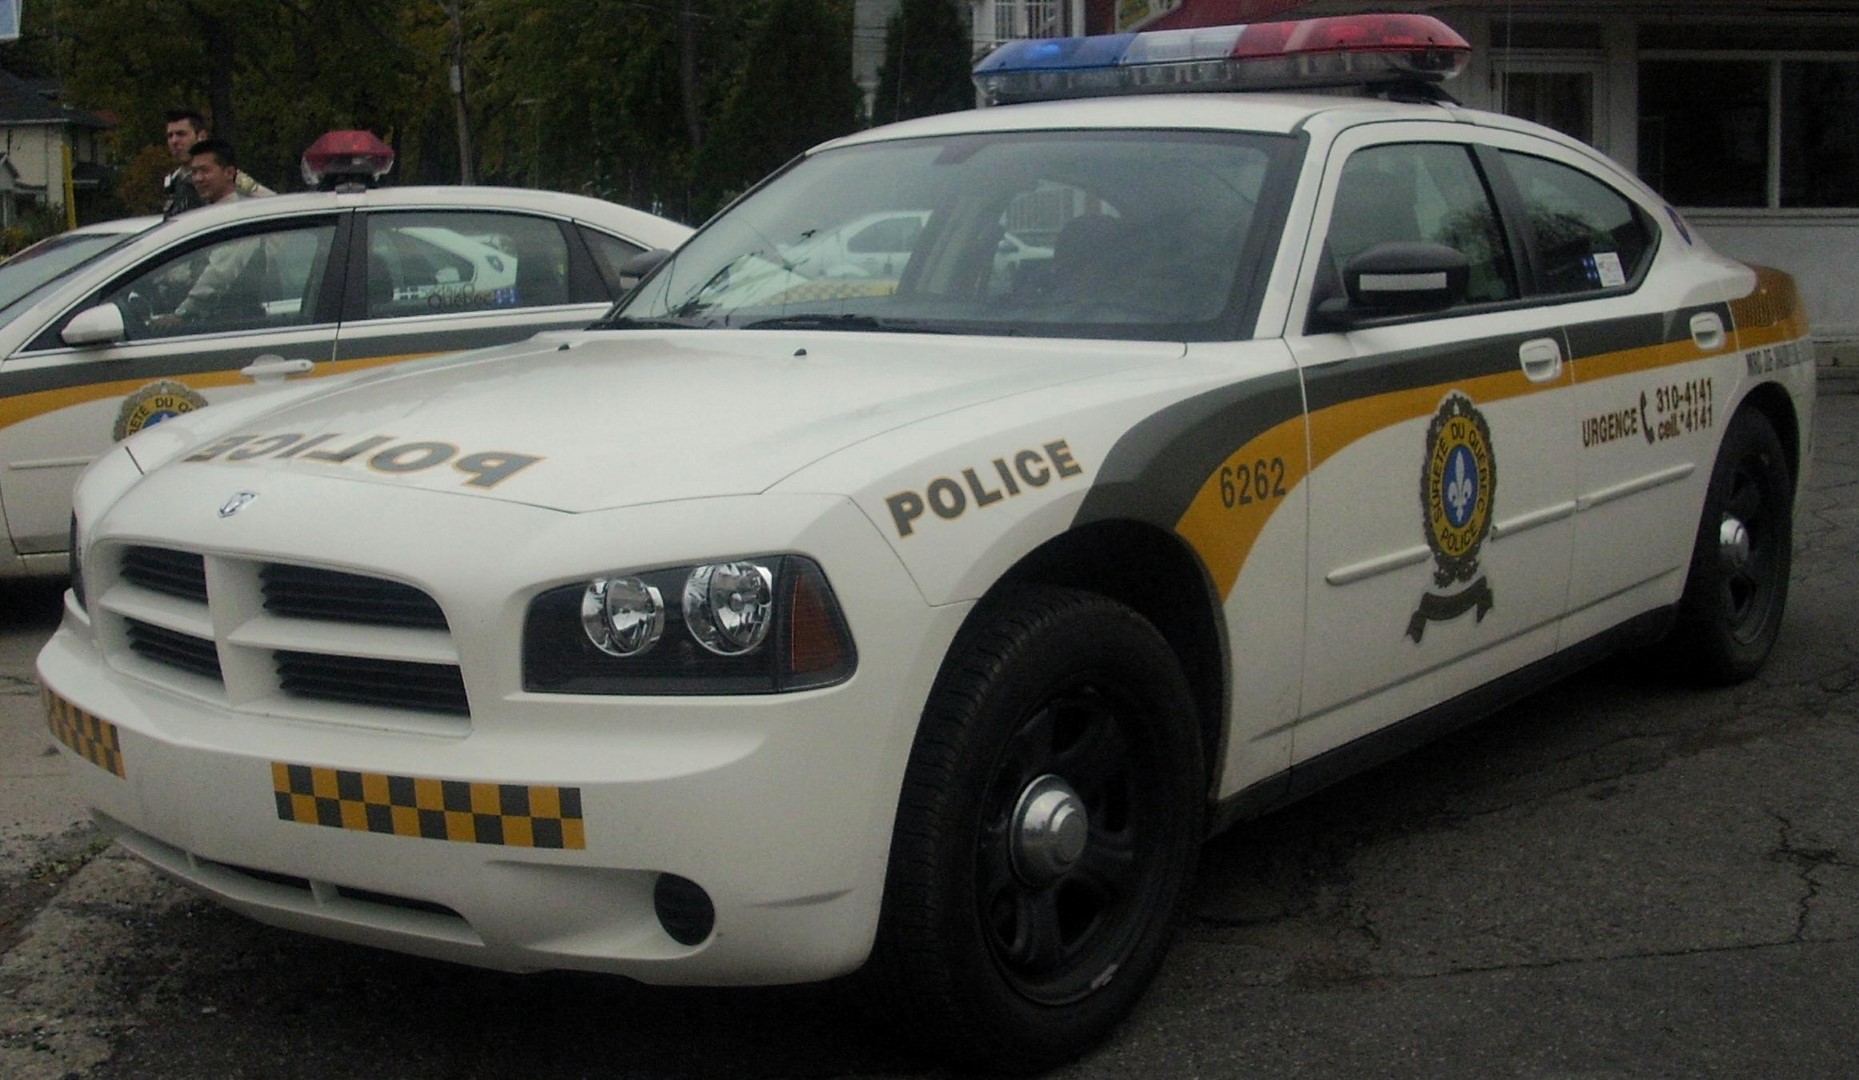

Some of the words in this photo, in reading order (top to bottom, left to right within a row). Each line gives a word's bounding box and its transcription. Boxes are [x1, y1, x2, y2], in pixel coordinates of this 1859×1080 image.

[155, 397, 173, 408] DU
[1656, 377, 1713, 413] 310-4141
[1451, 422, 1466, 440] DU
[1582, 408, 1638, 448] URGENCE
[884, 437, 1084, 539] POLICE
[1220, 457, 1287, 509] 6262
[1440, 520, 1479, 552] POLICE
